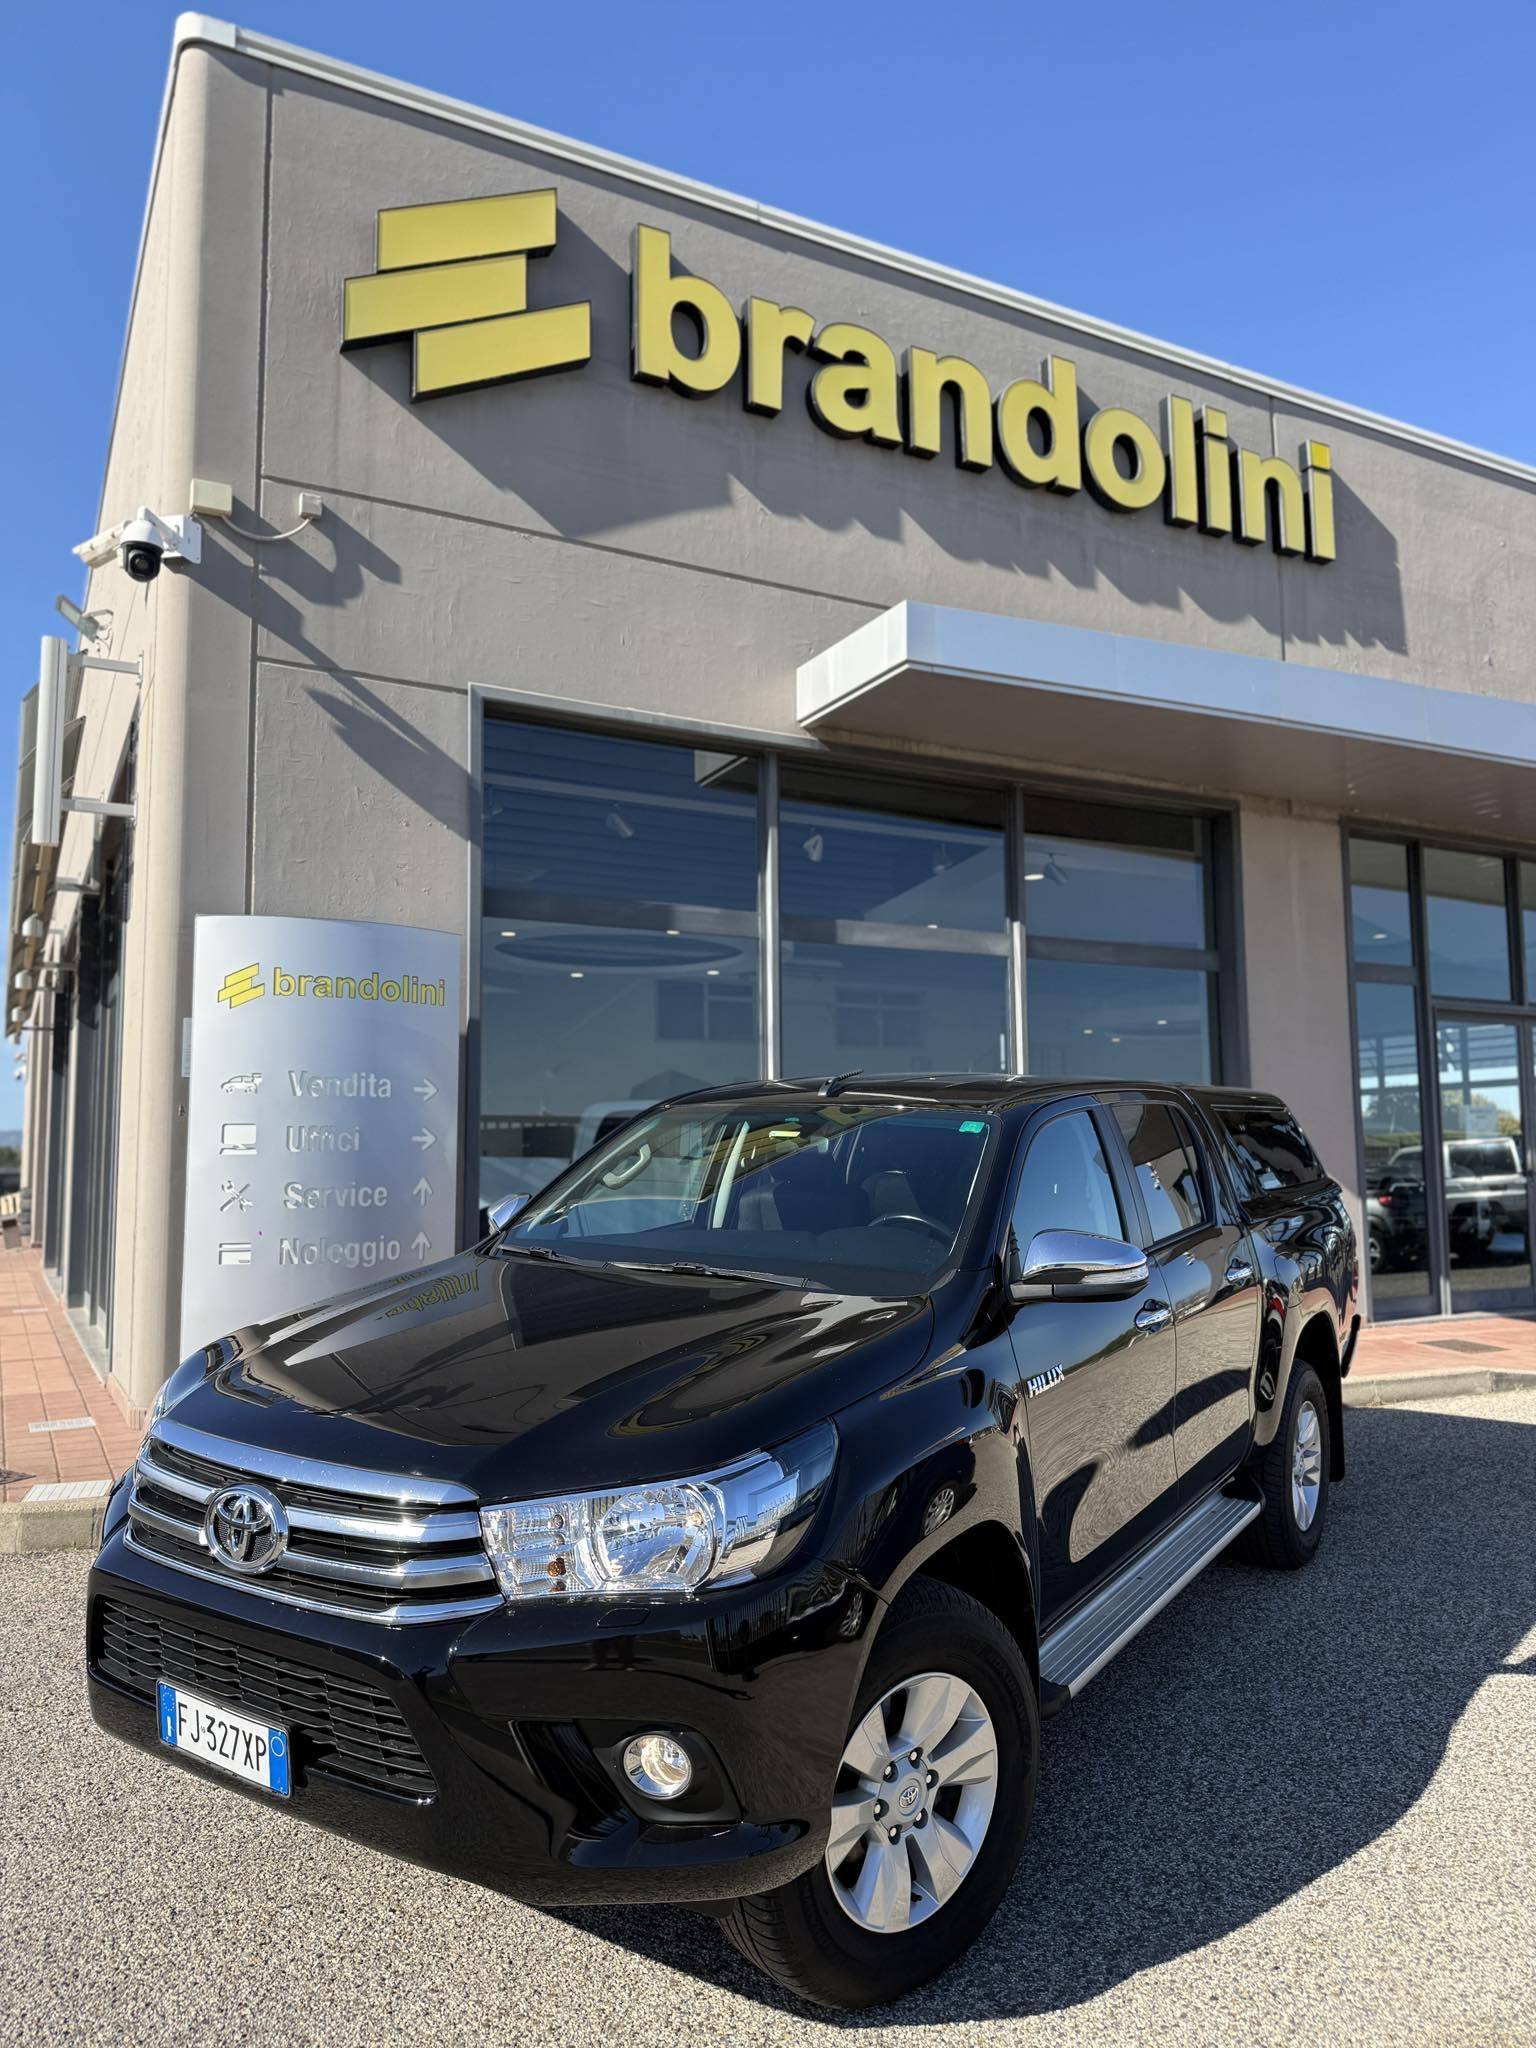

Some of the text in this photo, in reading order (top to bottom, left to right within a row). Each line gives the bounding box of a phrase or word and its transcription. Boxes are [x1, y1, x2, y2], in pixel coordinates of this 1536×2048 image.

[632, 223, 1337, 564] brandolini
[273, 966, 445, 1006] brandolini
[287, 1070, 392, 1098] Vendita
[283, 1181, 388, 1209] Service
[279, 1235, 401, 1268] Noleggio
[1027, 1363, 1065, 1398] HILUX
